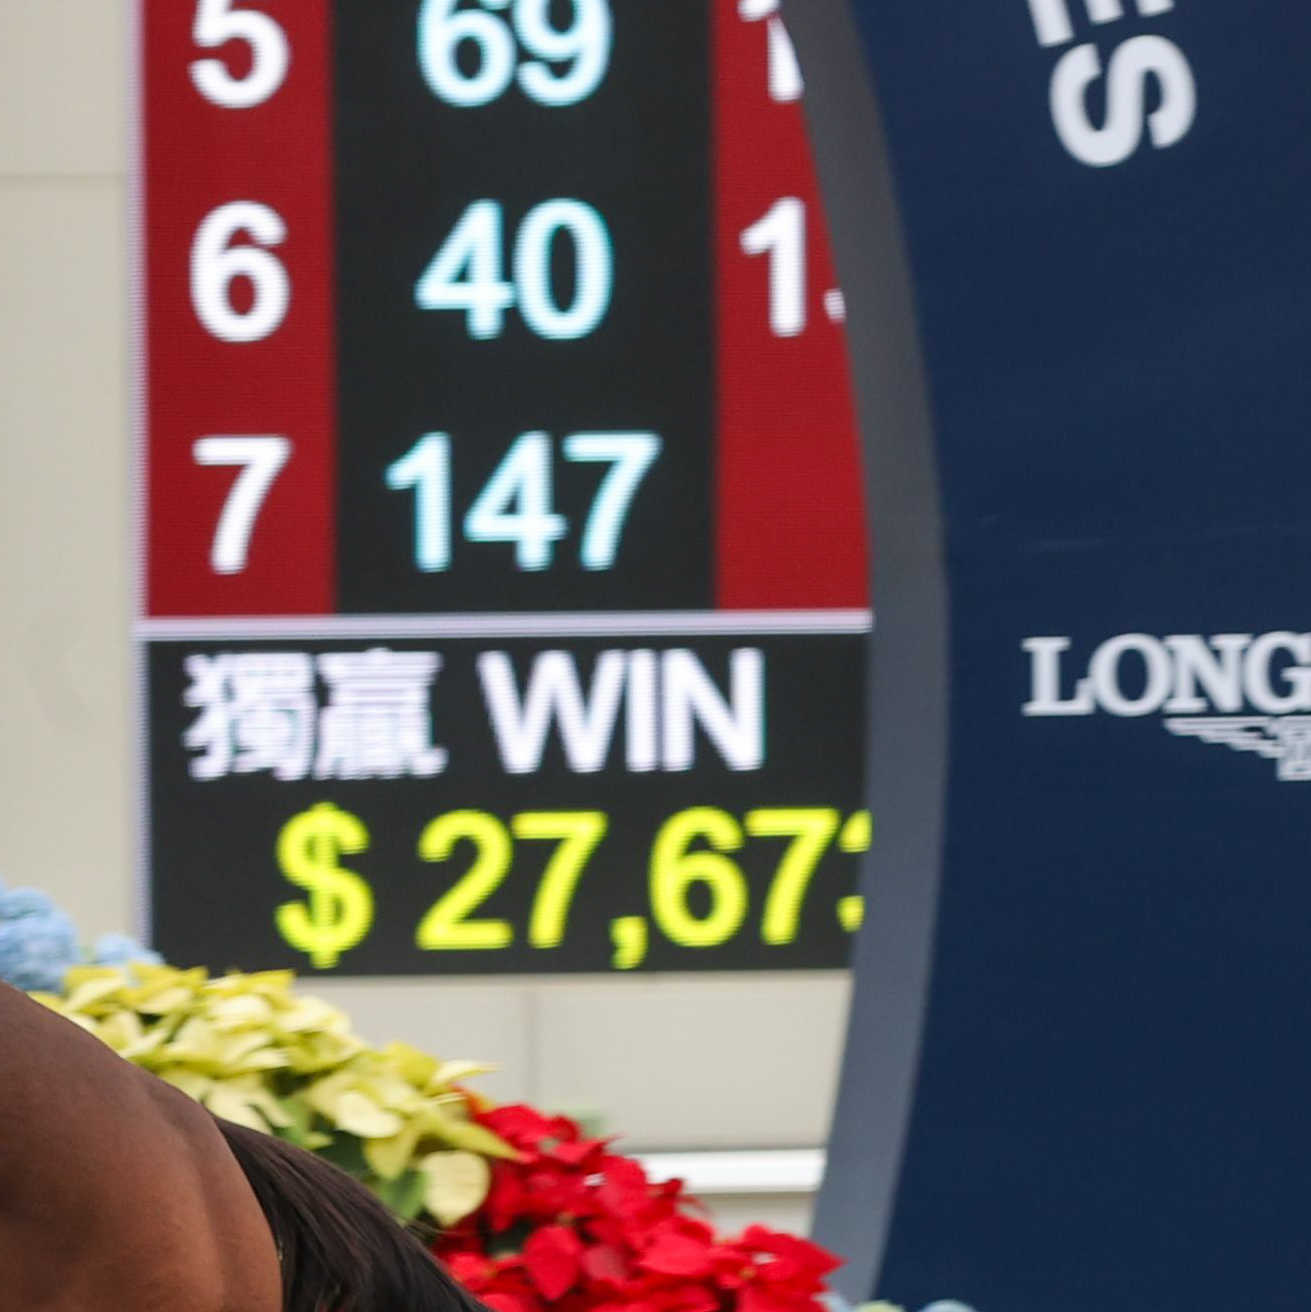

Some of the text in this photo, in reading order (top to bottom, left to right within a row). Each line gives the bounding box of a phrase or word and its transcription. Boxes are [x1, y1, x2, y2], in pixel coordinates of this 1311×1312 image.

[190, 0, 290, 108] 5
[417, 0, 612, 107] 69
[189, 200, 290, 342] 6
[415, 199, 613, 340] 40
[192, 431, 661, 574] 7 147
[181, 648, 765, 781] 獨贏 WIN
[274, 802, 371, 967] $
